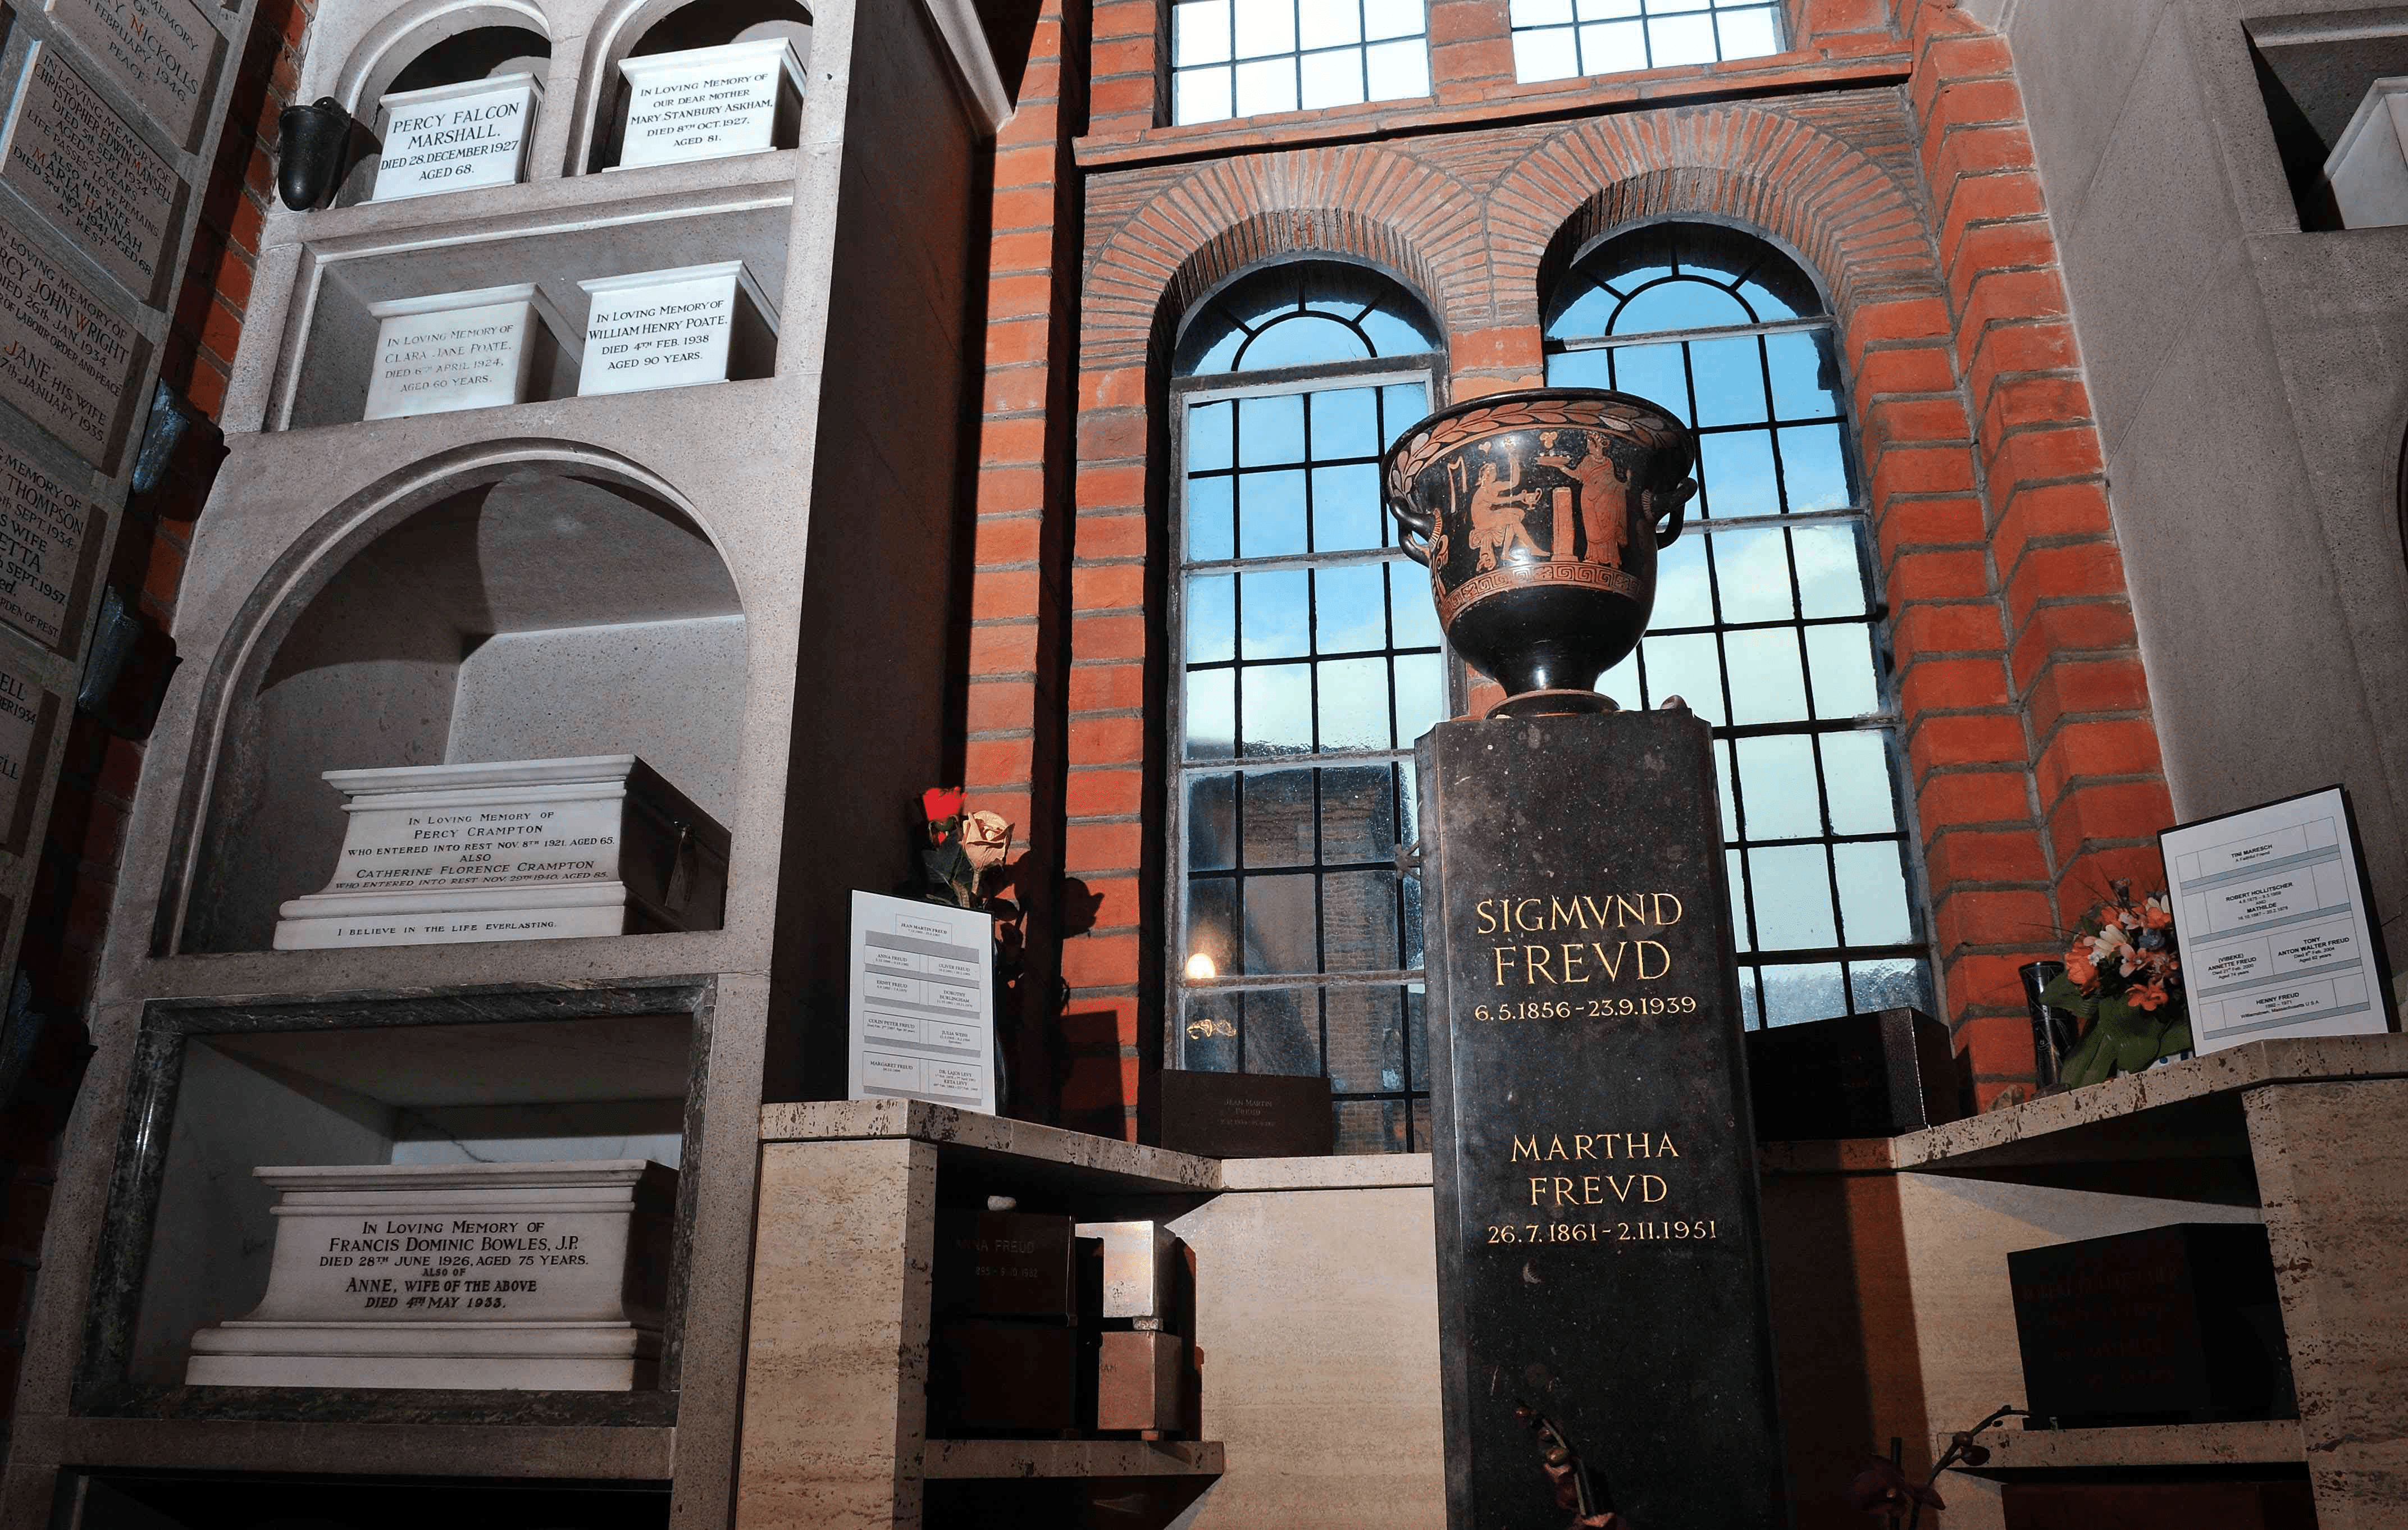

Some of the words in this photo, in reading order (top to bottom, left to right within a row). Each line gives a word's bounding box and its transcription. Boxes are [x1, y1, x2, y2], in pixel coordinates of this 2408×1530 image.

[131, 0, 149, 17] OF
[94, 2, 152, 65] FEBRUARY
[130, 13, 198, 94] NICKOLLS
[655, 83, 699, 95] LOVING
[704, 76, 749, 88] MEMORY
[653, 99, 674, 108] OUR
[678, 95, 705, 104] DEAR
[709, 89, 750, 101] MOTHER
[43, 54, 58, 74] IN
[57, 69, 103, 120] LOVING
[103, 116, 156, 169] MEMORY
[157, 167, 171, 184] OF
[393, 114, 445, 134] PERCY
[453, 102, 519, 124] FALCON
[631, 114, 662, 125] MARY
[663, 106, 722, 121] STANBURY
[34, 63, 99, 135] CHRISTOPHER
[99, 127, 132, 165] EDWIN
[131, 158, 172, 205] MANSELL
[408, 124, 500, 149] MARSHALL.
[673, 137, 703, 147] AGED
[27, 109, 51, 136] LIFE
[53, 132, 88, 171] PASSES
[92, 170, 118, 200] LOVE
[418, 167, 452, 181] AGED
[455, 164, 474, 175] 68.
[50, 150, 80, 180] ALSO
[83, 179, 101, 199] HIS
[106, 198, 131, 227] WIFE
[32, 147, 79, 199] MARIA
[85, 194, 142, 253] HANNAH
[29, 278, 73, 321] JOHN
[76, 308, 129, 364] WRIGHT
[596, 314, 609, 323] IN
[613, 308, 655, 321] LOVING
[660, 303, 706, 315] MEMORY
[710, 300, 724, 309] OF
[589, 326, 640, 340] WILLIAM
[642, 321, 683, 334] HENRY
[686, 315, 727, 329] POATE.
[3, 298, 16, 312] OF
[15, 307, 50, 341] LABOUR
[50, 336, 78, 364] ORDER
[77, 358, 95, 377] AND
[602, 344, 628, 355] DIED
[656, 339, 679, 348] FEB.
[684, 335, 709, 345] 1938
[385, 351, 426, 364] CLARA
[432, 346, 465, 358] JANE
[608, 359, 639, 370] AGED
[644, 357, 659, 366] 90
[663, 351, 703, 363] YEARS.
[4, 340, 51, 382] JANE
[52, 377, 74, 401] HIS
[76, 393, 106, 426] WIFE
[17, 374, 78, 421] JANUARY
[4, 454, 63, 499] MEMORY
[64, 494, 81, 510] OF
[7, 473, 84, 538] THOMPSON
[11, 519, 48, 554] WIFE
[24, 611, 37, 624] OF
[428, 816, 472, 824] LOVING
[480, 813, 531, 821] MEMORY
[414, 830, 456, 839] PERCY
[467, 825, 542, 837] CRAMPTON
[376, 846, 428, 855] ENTERED
[569, 838, 598, 846] AGED
[2243, 844, 2273, 855] MARESCH
[459, 854, 491, 862] ALSO
[356, 868, 433, 878] CATHERINE
[440, 865, 510, 874] FLORENCE
[517, 861, 594, 871] CRAMPTON
[2225, 892, 2250, 902] ROBERT
[2251, 882, 2293, 896] HOLLITSCHER
[1476, 893, 1682, 934] SIGMVND
[2247, 902, 2277, 913] MATHILDE
[486, 921, 556, 930] EVERLASTING.
[2278, 948, 2299, 956] ANTON
[2300, 942, 2327, 952] WALTER
[2328, 937, 2350, 946] FREUD
[1494, 942, 1671, 985] FREVD
[2208, 961, 2235, 971] ANNETTE
[2236, 957, 2256, 965] FREUD
[2218, 953, 2244, 963] (VIBEKE)
[2278, 992, 2299, 1001] FREUD
[1511, 1131, 1679, 1162] MARTHA
[1530, 1175, 1667, 1207] FREVD
[362, 1222, 377, 1234] IN
[386, 1221, 443, 1234] LOVING
[452, 1221, 518, 1234] MEMORY
[527, 1222, 545, 1232] OF
[329, 1237, 399, 1252] FRANCIS
[405, 1237, 474, 1252] DOMINIC
[481, 1237, 550, 1252] BOWLES,
[320, 1257, 353, 1267] DIED
[394, 1257, 430, 1266] JUNE
[476, 1256, 511, 1266] AGED
[519, 1256, 534, 1266] 75
[540, 1255, 588, 1265] YEARS.
[422, 1268, 448, 1277] ALSO
[453, 1268, 466, 1276] OF
[345, 1277, 396, 1294] ANNE,
[405, 1280, 440, 1292] WIFE
[444, 1280, 460, 1292] OF
[464, 1280, 491, 1292] THE
[493, 1280, 537, 1292] ABOVE
